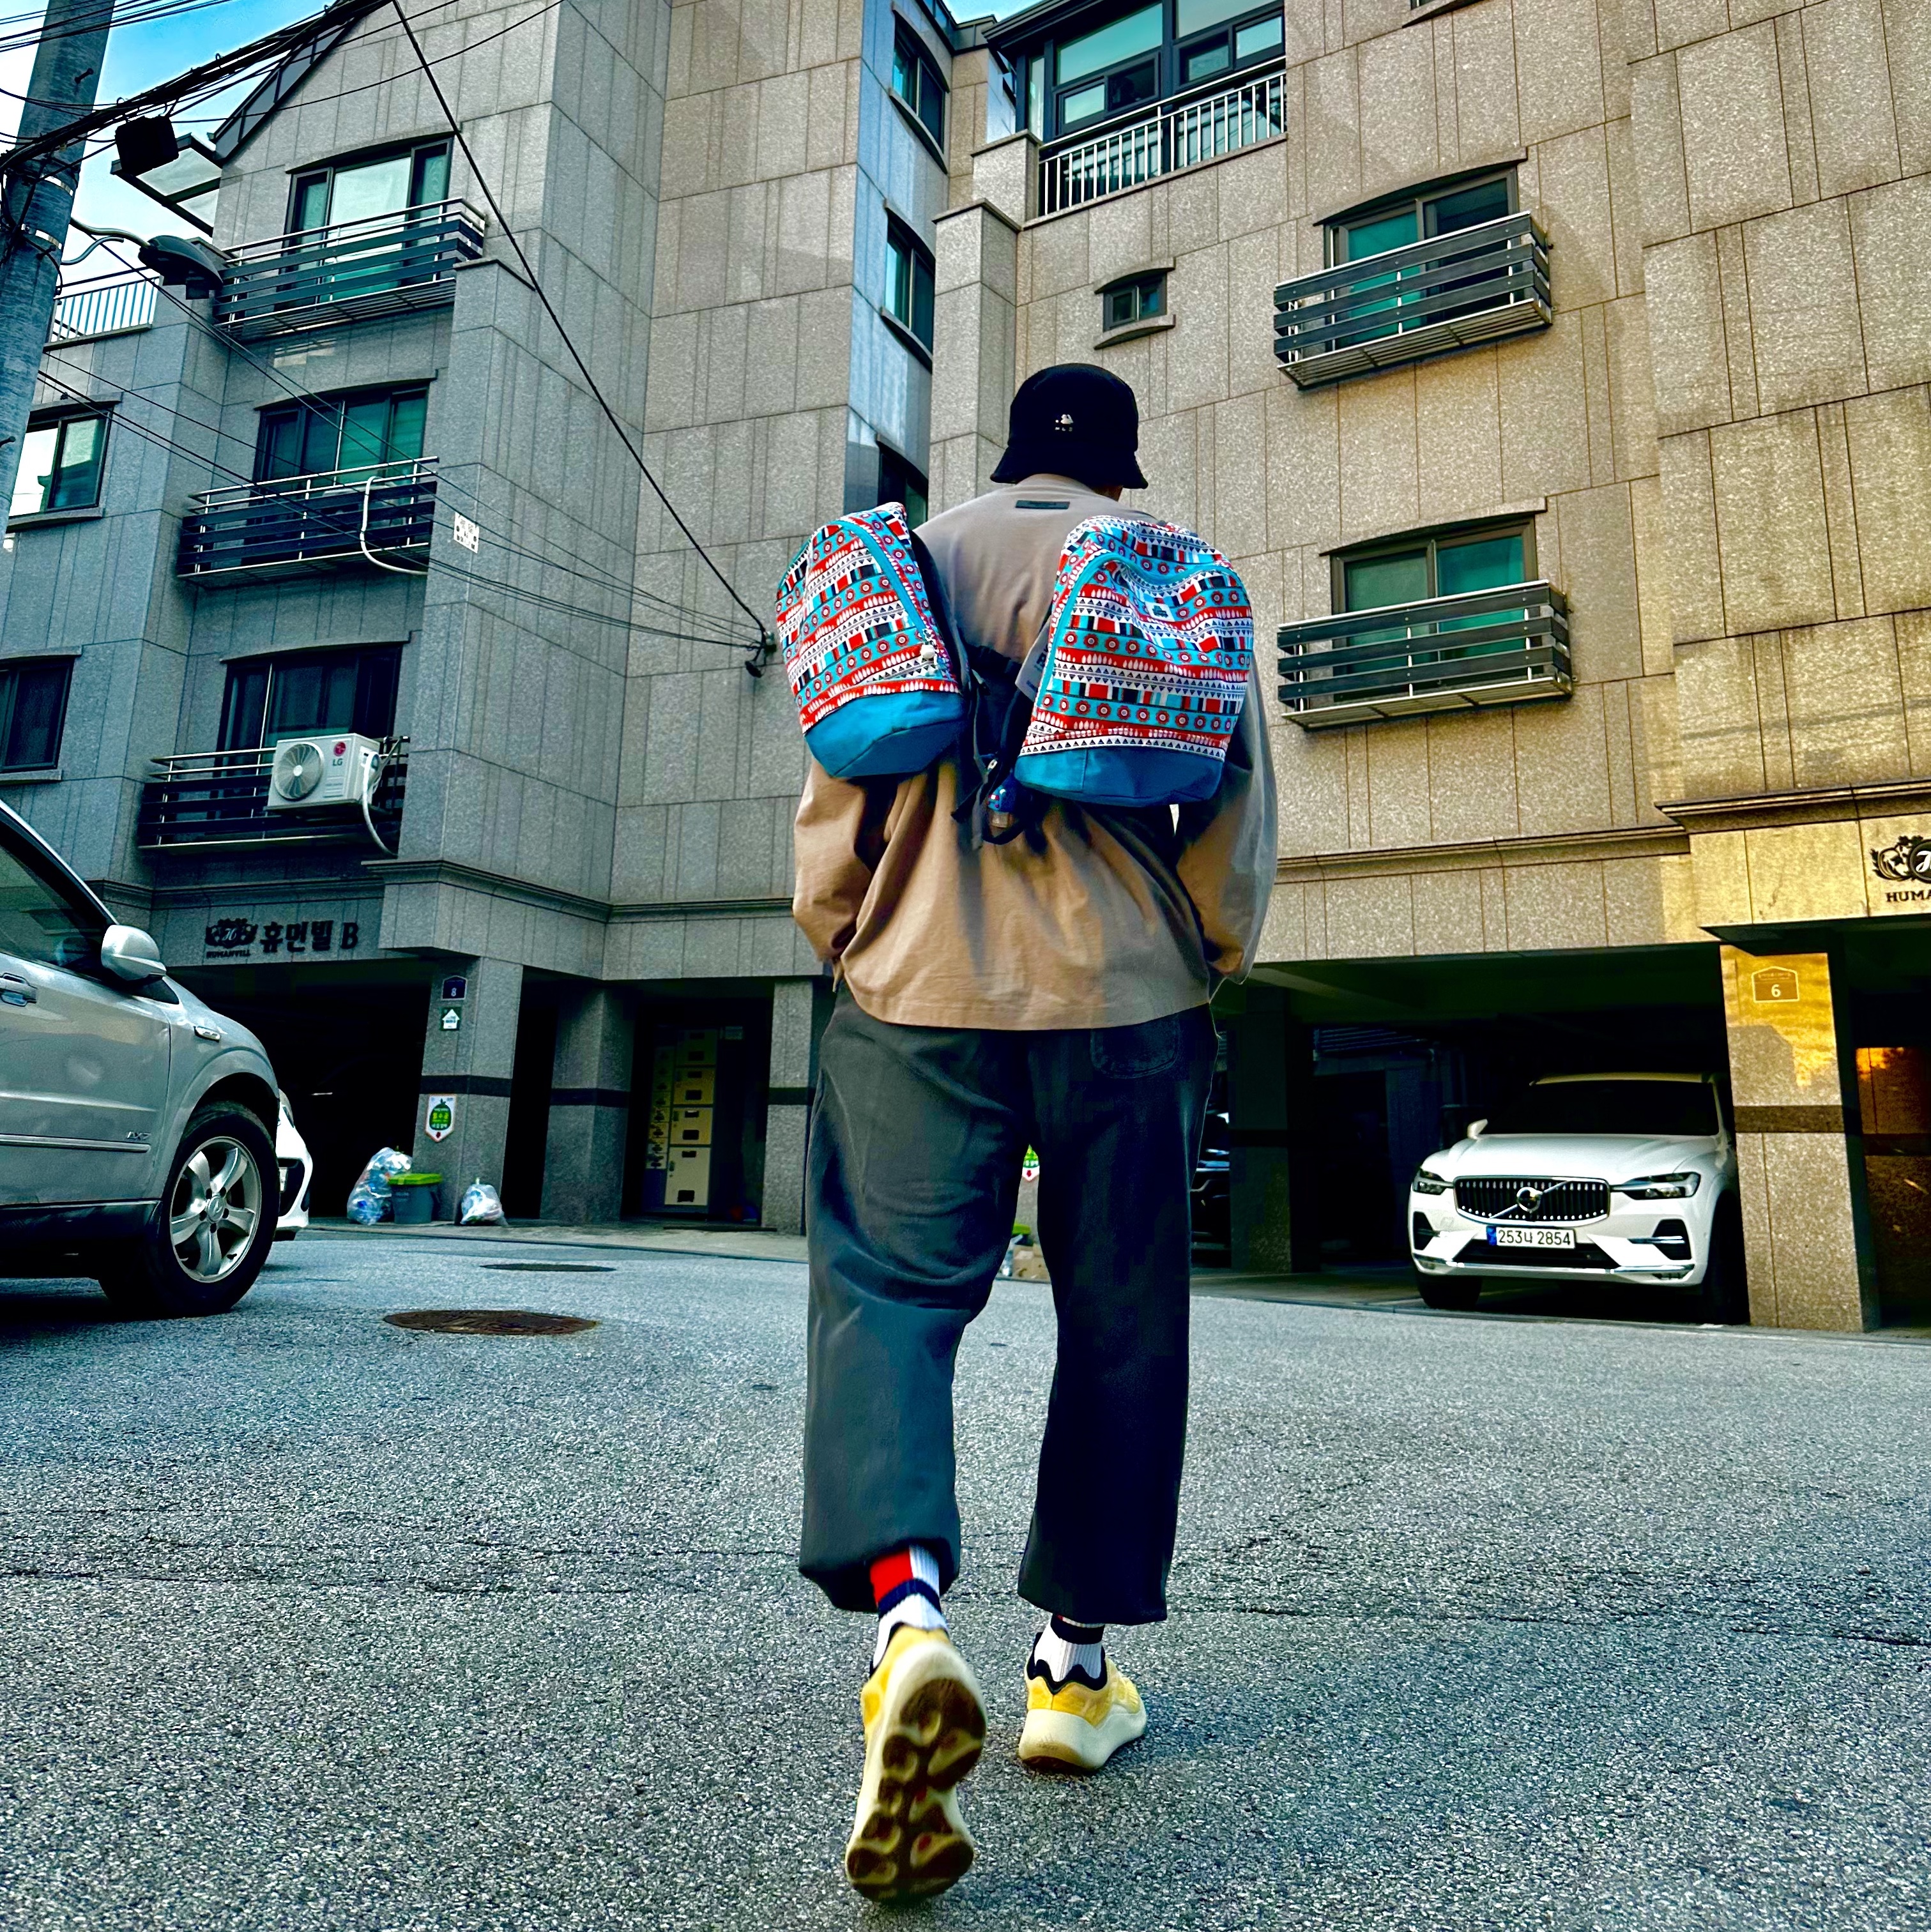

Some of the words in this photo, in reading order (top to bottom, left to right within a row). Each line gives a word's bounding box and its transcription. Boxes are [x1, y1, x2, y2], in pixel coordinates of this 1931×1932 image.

[332, 758, 343, 766] LG
[260, 920, 334, 953] 휴먼빌
[340, 922, 359, 949] B
[1771, 984, 1781, 998] 6
[1537, 1231, 1571, 1245] 2854
